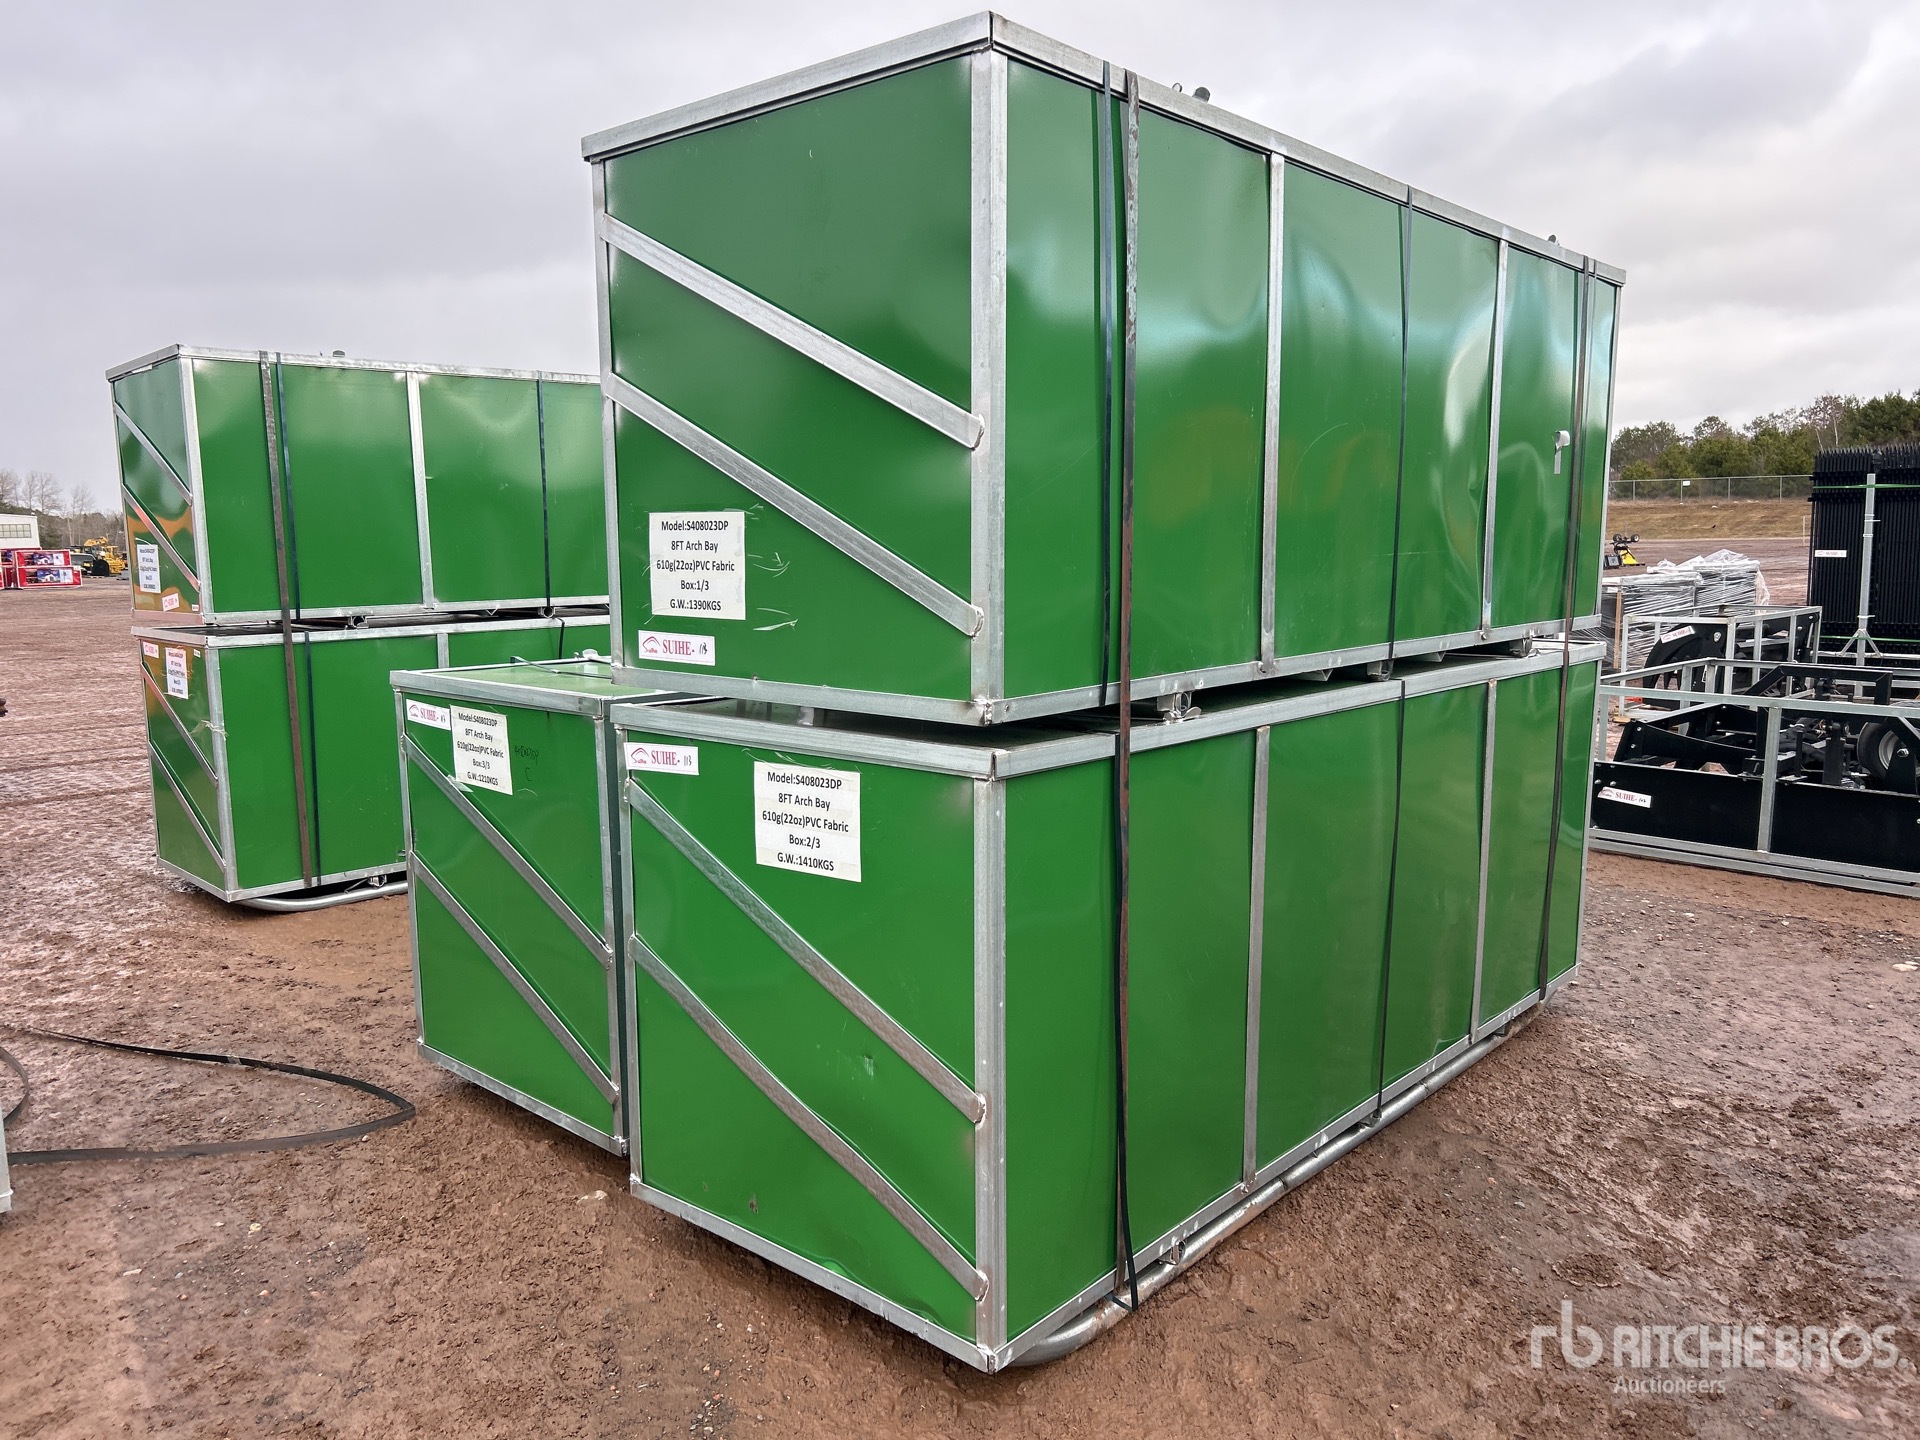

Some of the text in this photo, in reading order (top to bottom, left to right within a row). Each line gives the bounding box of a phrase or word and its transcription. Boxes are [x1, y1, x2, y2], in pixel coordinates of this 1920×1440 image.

[661, 520, 729, 532] Model:S408023DP
[671, 540, 719, 553] 8FT Arch Bay
[656, 559, 735, 573] 610g(22oz)PVC Fabric
[680, 579, 710, 593] Box:1/3
[670, 598, 722, 611] G.W.:1390KGS
[458, 712, 498, 727] Model:S408023DP
[465, 728, 494, 743] 8FT Arch Bay
[456, 740, 504, 758] 610g(22oz)PVC Fabric
[472, 758, 491, 770] Box:3/3
[767, 771, 842, 790] Model:S408023DP
[778, 792, 831, 811] 8FT Arch Bay
[762, 810, 849, 833] 610g(22oz)PVC Fabric
[789, 834, 821, 849] Box:2/3
[777, 852, 834, 872] G.W.:1410KGS
